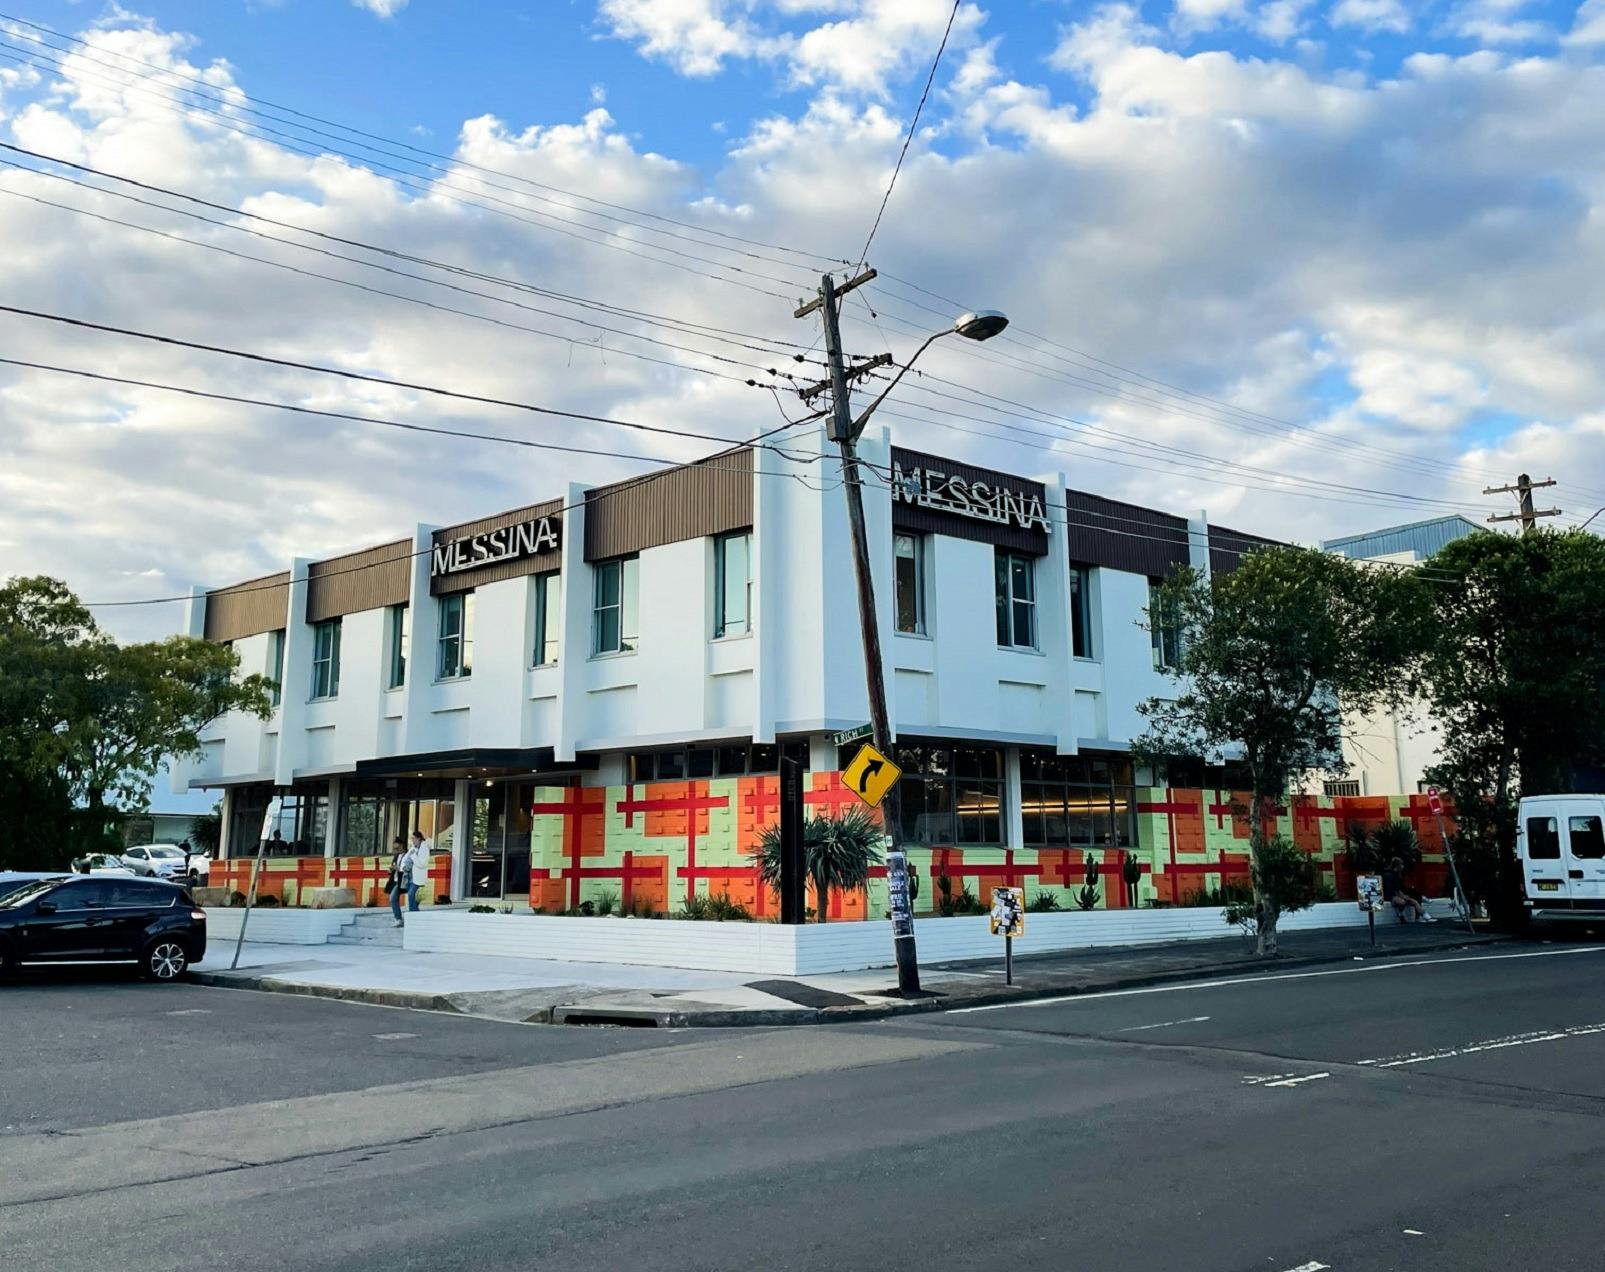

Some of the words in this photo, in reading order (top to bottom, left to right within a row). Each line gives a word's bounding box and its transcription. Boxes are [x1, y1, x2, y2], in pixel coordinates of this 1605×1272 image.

[892, 460, 1051, 534] MESSINA
[431, 517, 558, 577] MESSINA
[840, 730, 858, 742] RICH
